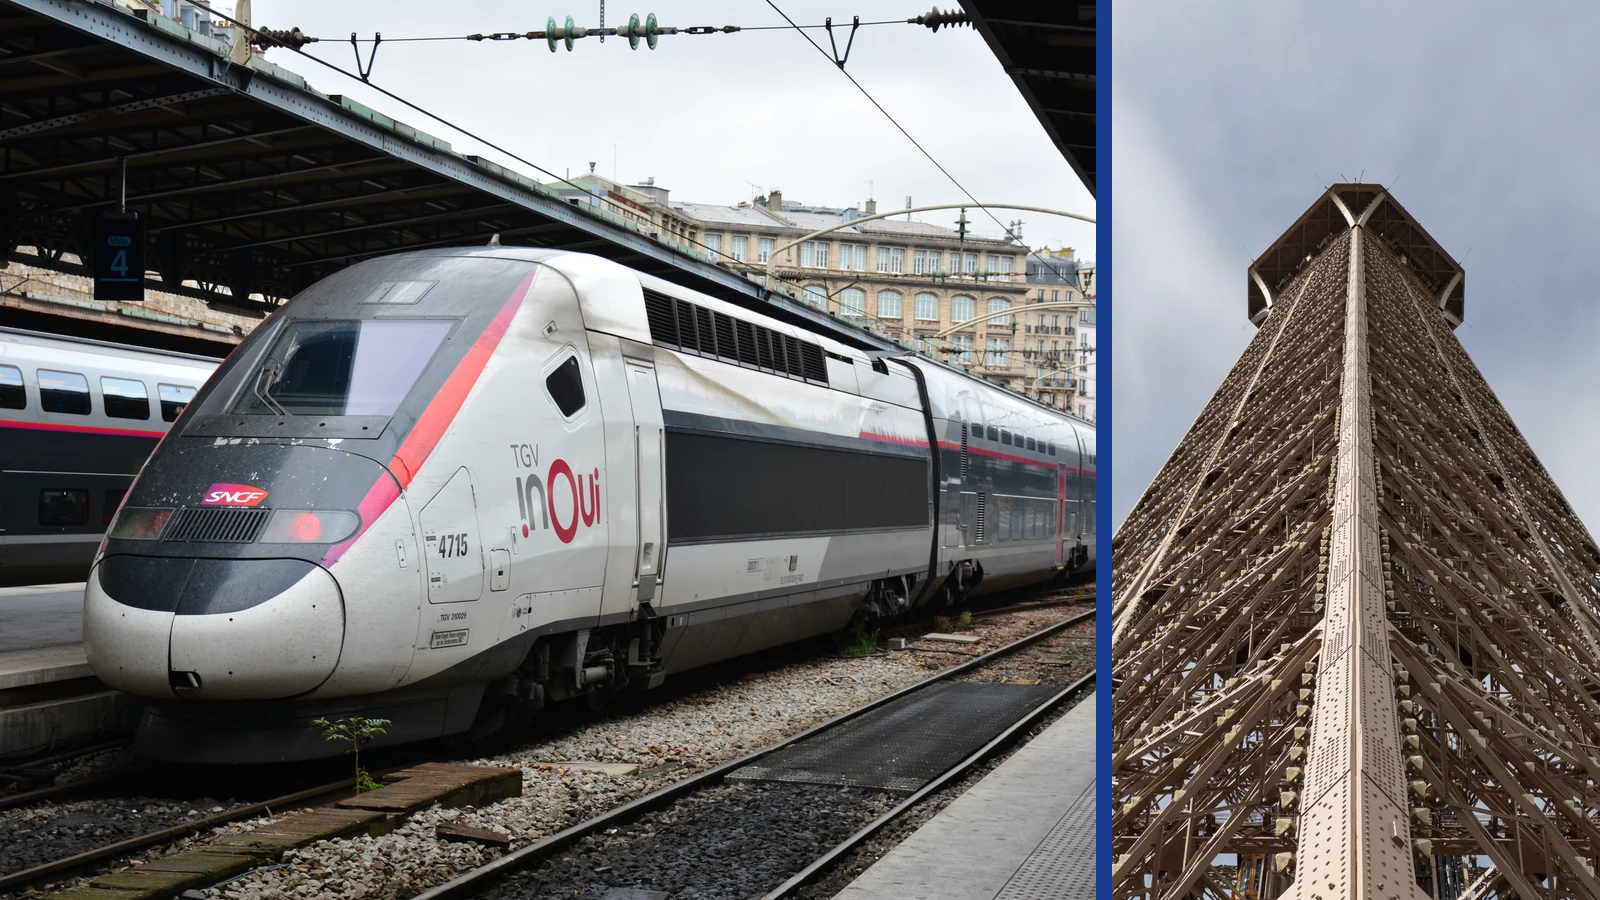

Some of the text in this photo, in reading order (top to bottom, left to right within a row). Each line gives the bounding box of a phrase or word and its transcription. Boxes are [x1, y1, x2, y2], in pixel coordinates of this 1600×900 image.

[110, 237, 129, 245] Voie
[110, 250, 128, 276] 4
[509, 443, 539, 468] TGV
[205, 492, 264, 502] SNCF
[439, 533, 467, 558] 4715
